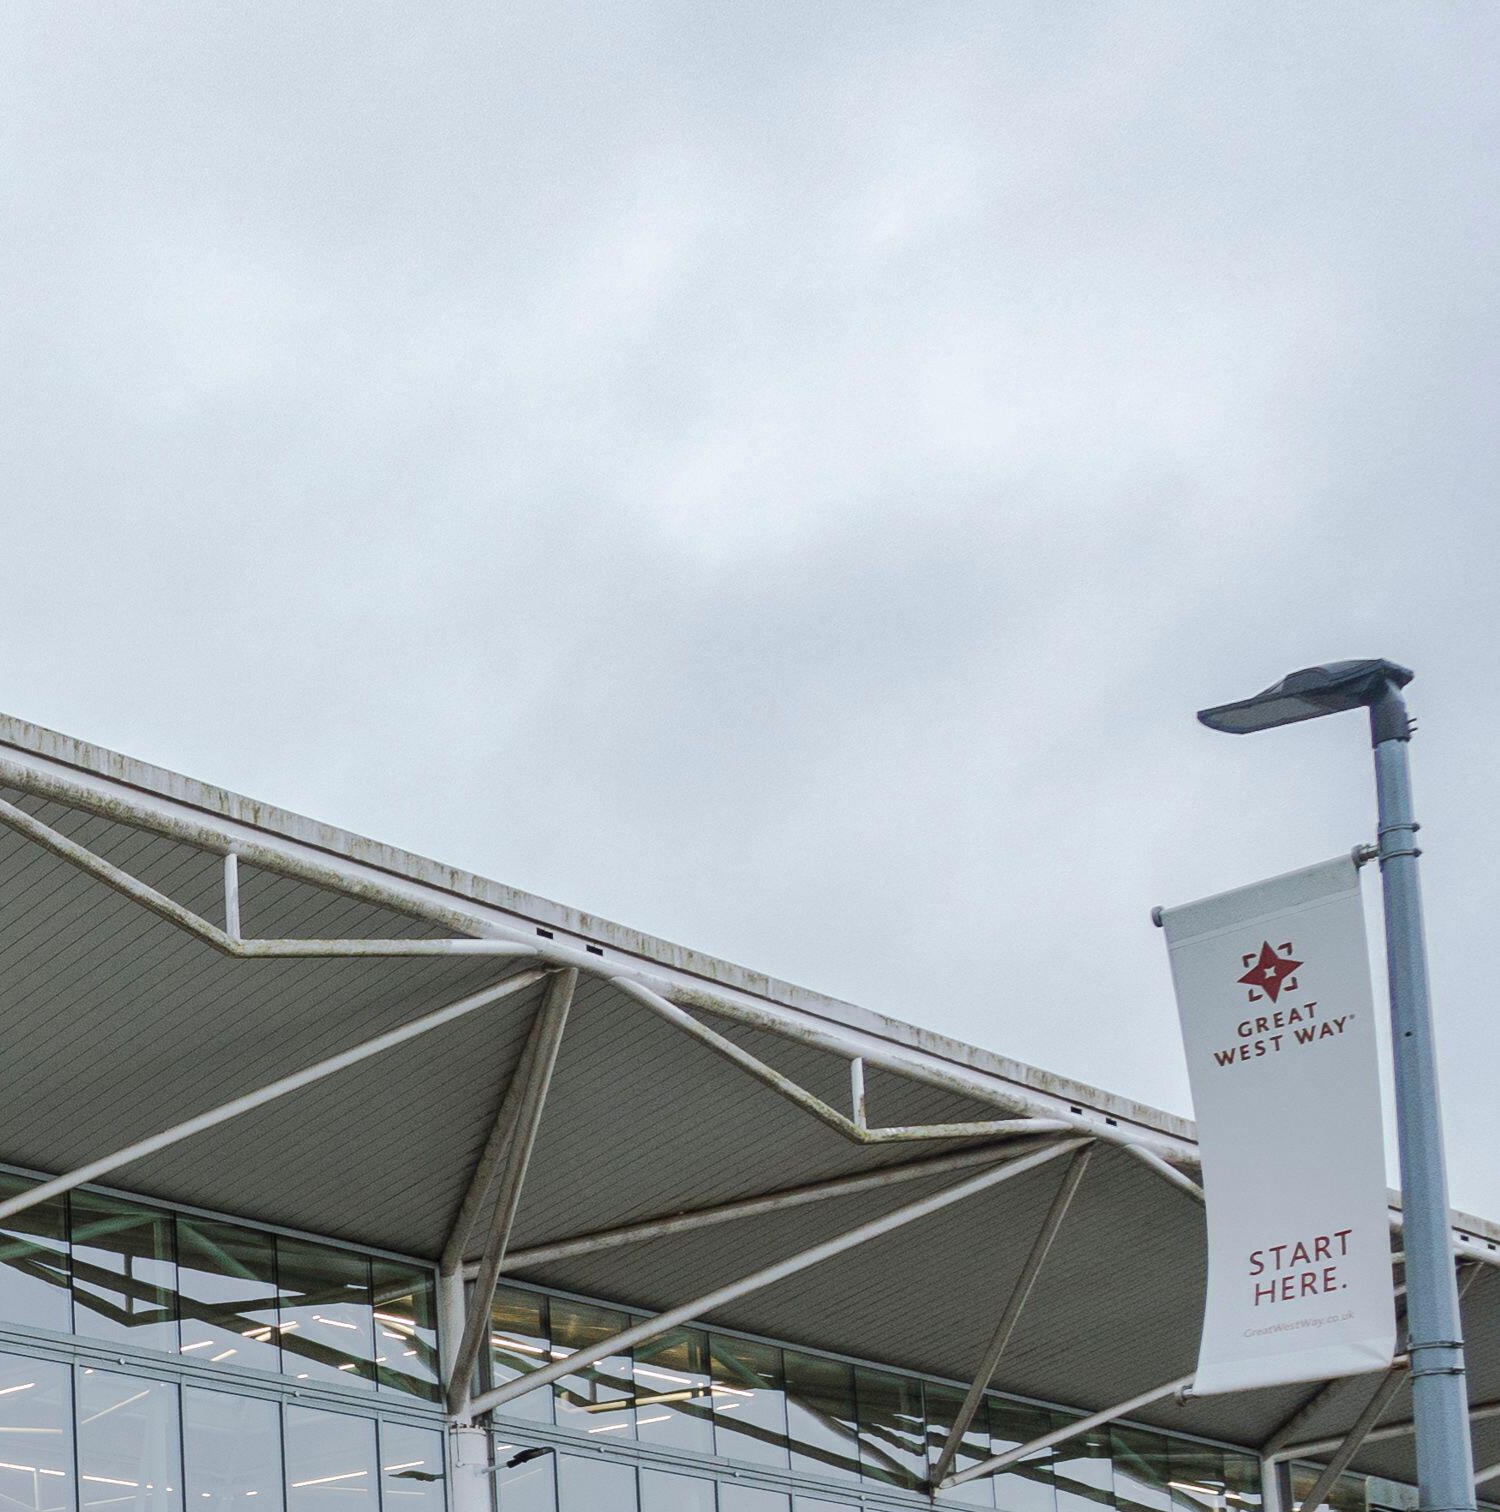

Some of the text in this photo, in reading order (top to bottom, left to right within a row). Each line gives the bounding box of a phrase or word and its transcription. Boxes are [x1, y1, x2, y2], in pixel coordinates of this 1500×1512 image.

[1237, 1001, 1318, 1038] GREAT
[1213, 1034, 1283, 1067] WEST
[1249, 1229, 1353, 1276] START
[1254, 1266, 1347, 1306] HERE.
